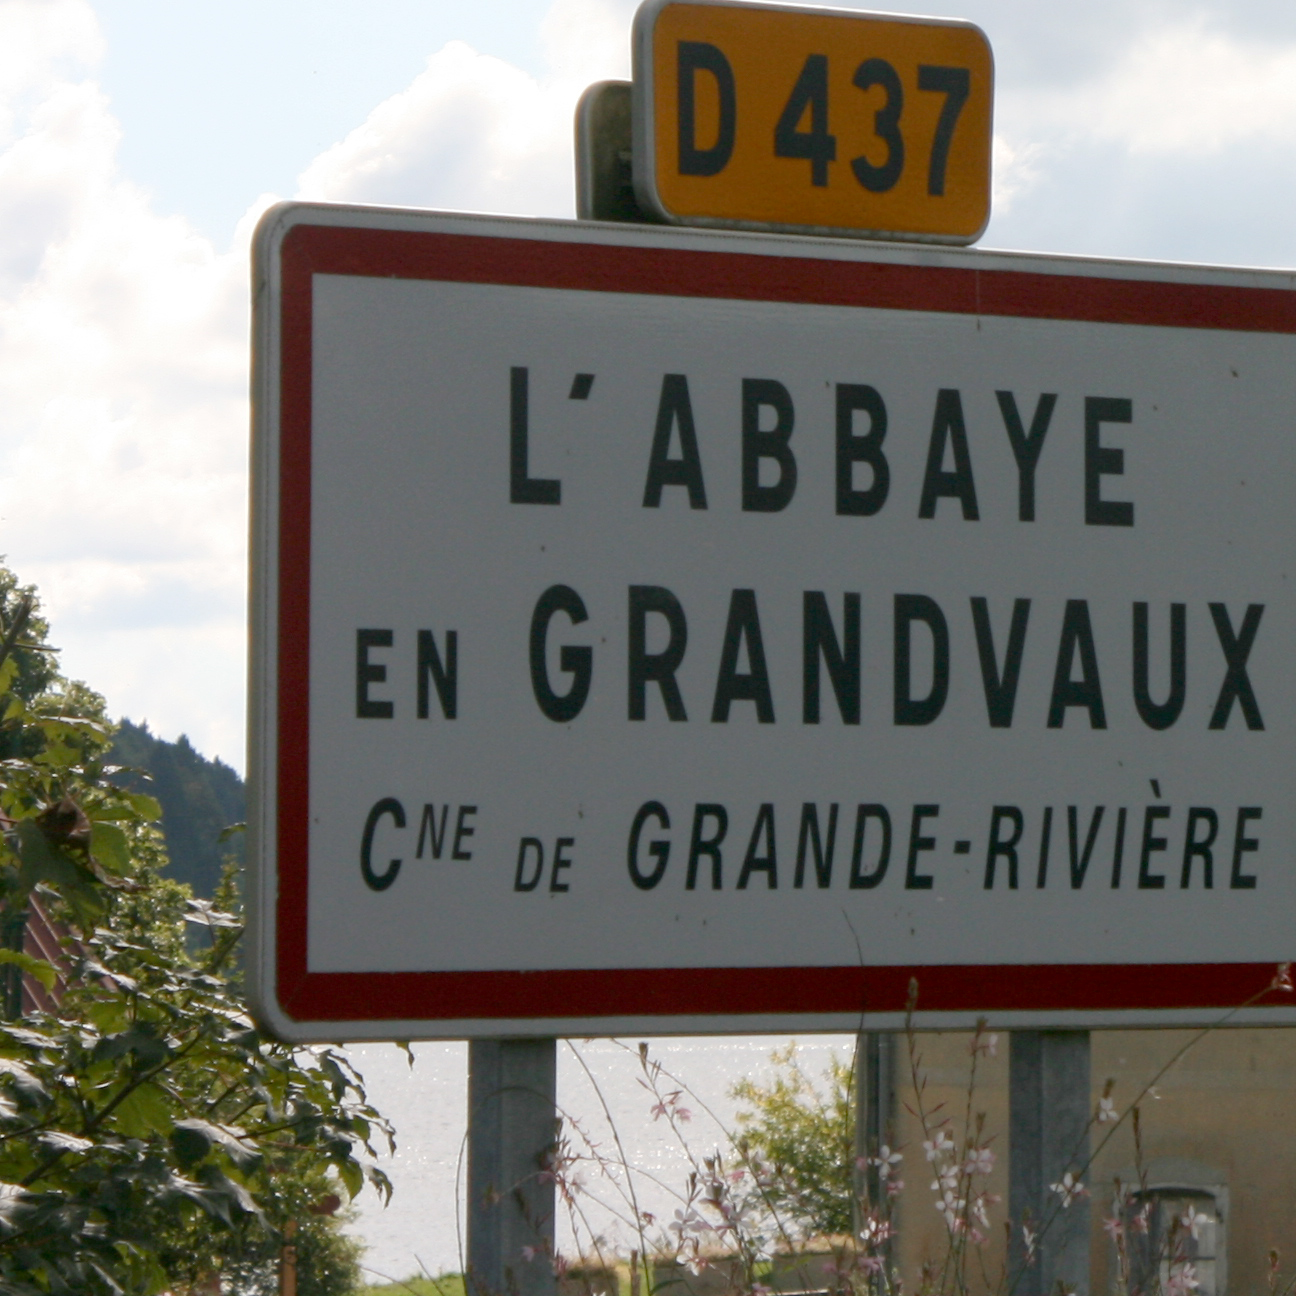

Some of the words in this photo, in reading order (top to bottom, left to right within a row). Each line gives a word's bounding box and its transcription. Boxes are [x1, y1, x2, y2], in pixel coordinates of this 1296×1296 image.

[677, 40, 737, 178] D
[773, 53, 971, 197] 437
[354, 627, 459, 722] EN
[527, 582, 1267, 733] GRANDVAUX
[512, 835, 577, 895] DE
[625, 777, 1264, 894] GRANDE-RIVIÈRE
